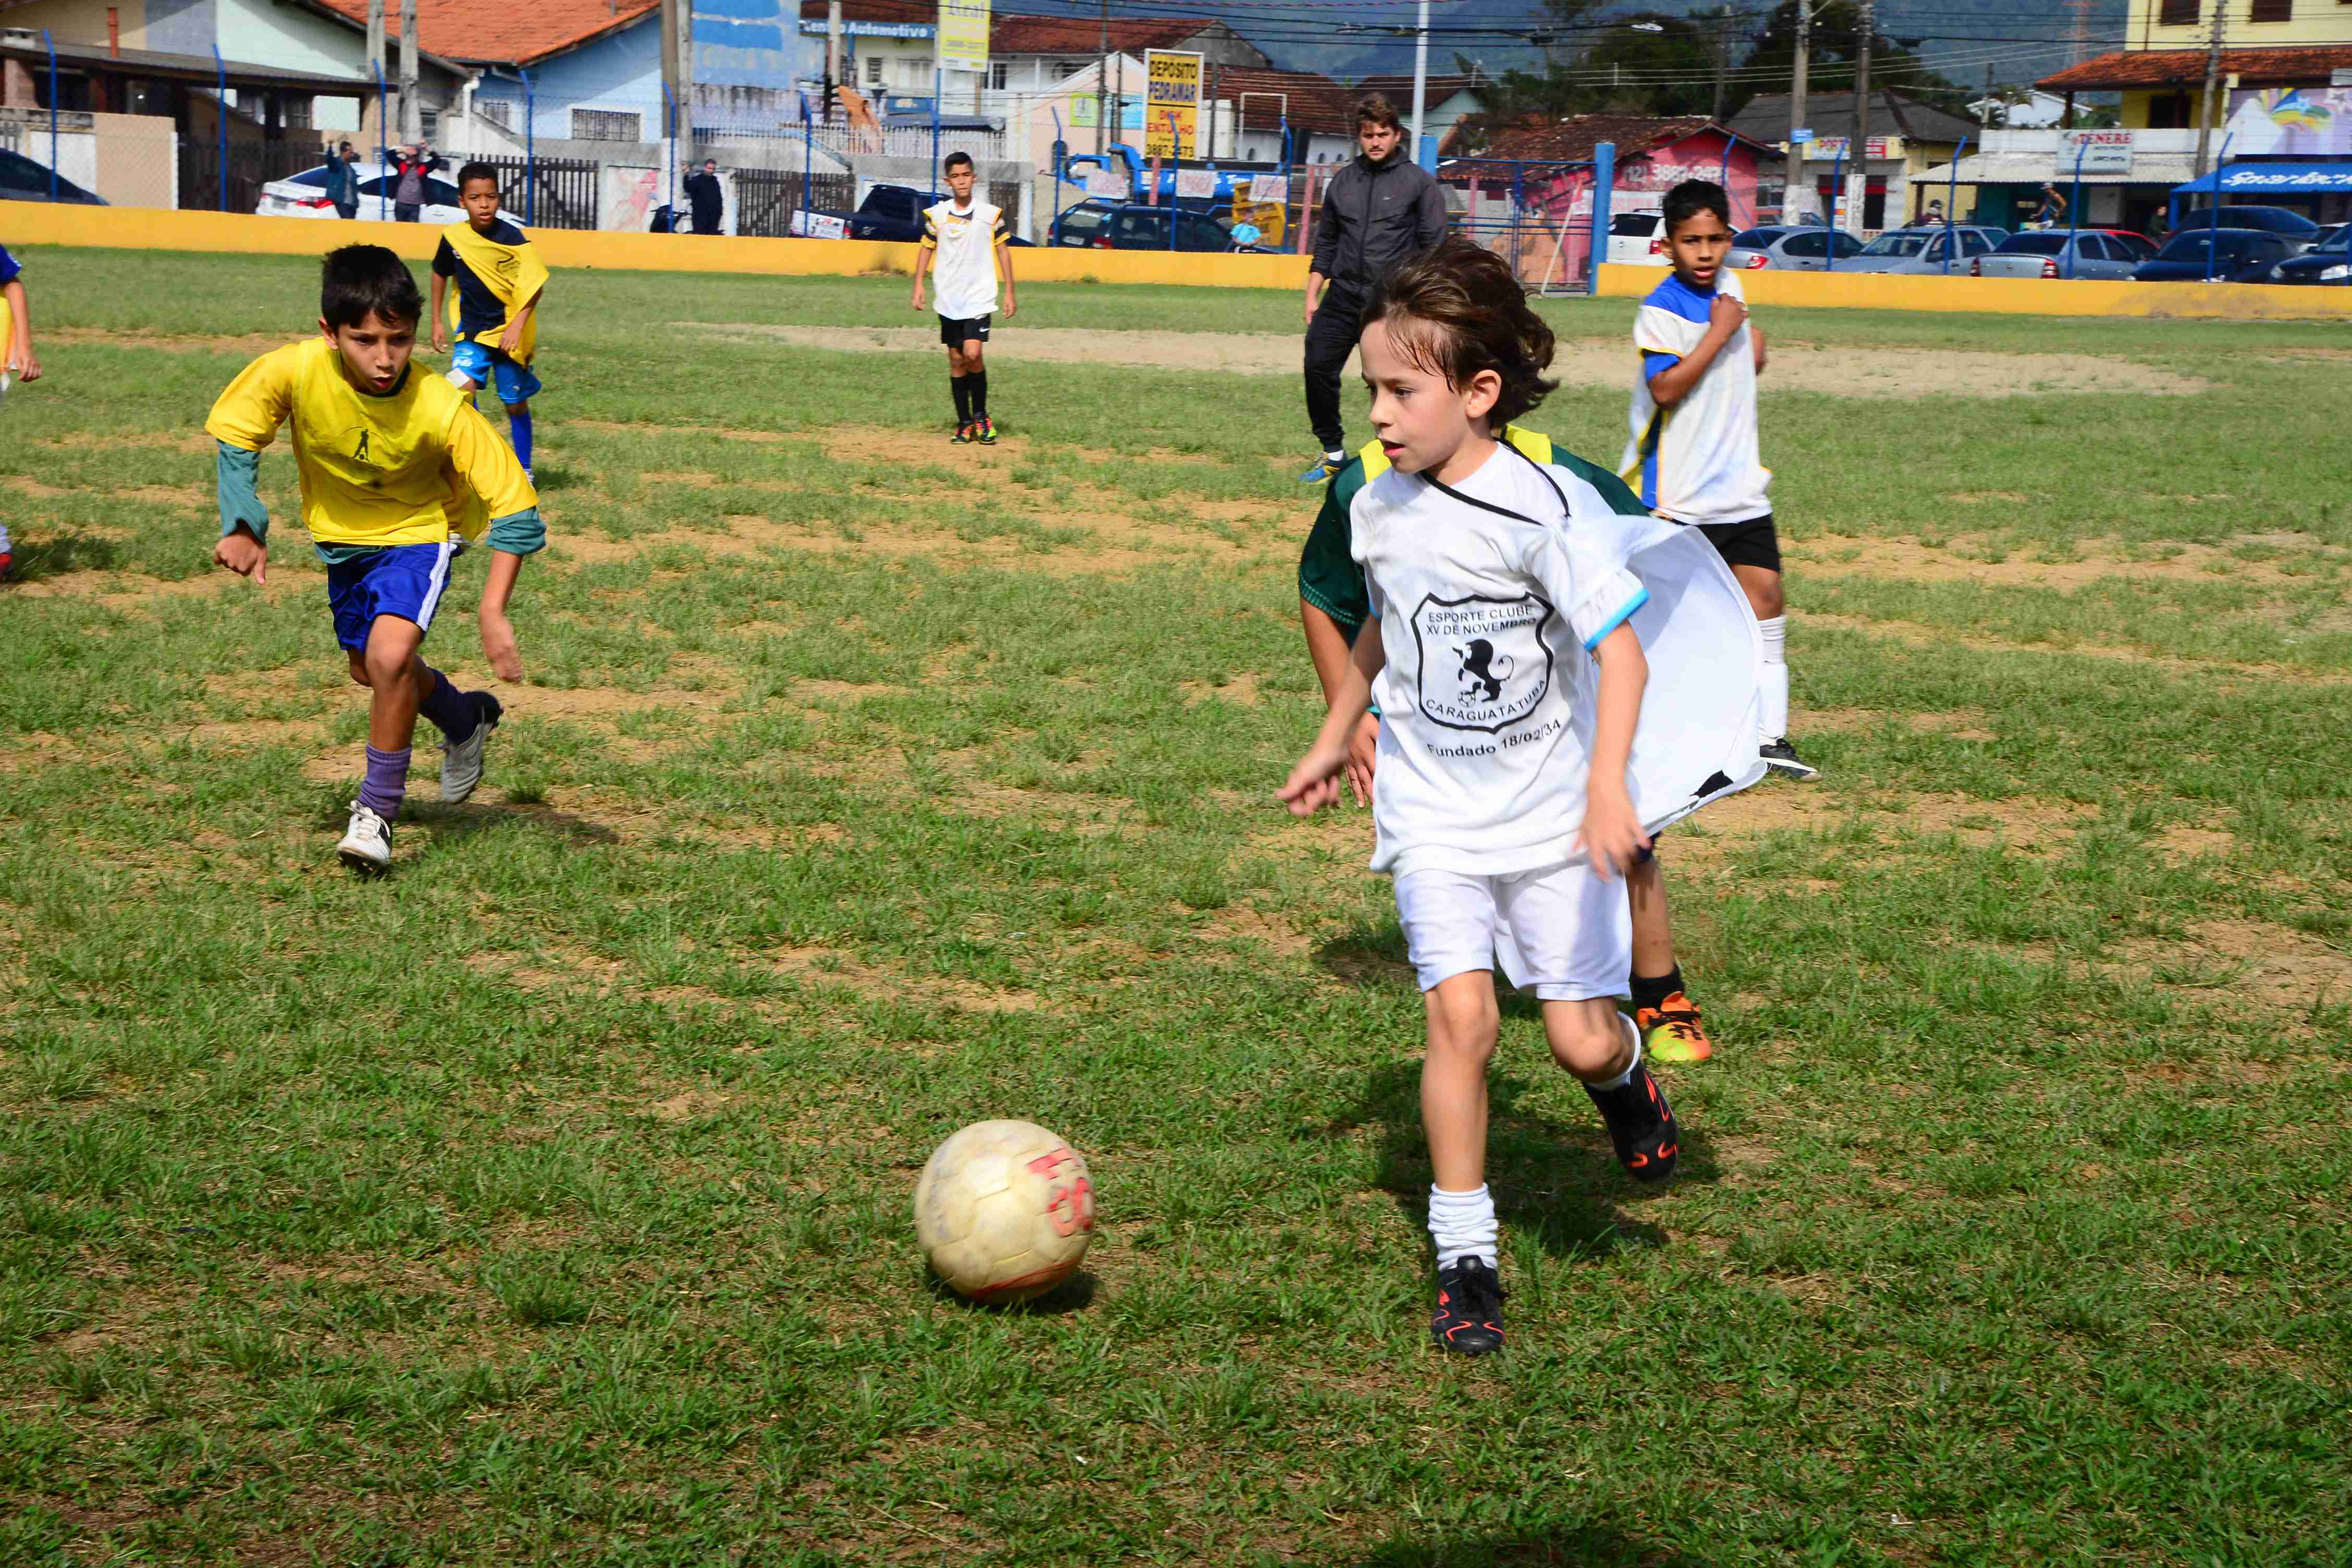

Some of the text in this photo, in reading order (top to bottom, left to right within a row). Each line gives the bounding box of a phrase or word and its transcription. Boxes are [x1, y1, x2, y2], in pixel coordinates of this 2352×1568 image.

[799, 19, 846, 34] Ceno
[1149, 80, 1195, 102] PEDRAMAR
[1147, 123, 1194, 135] ENTUHO
[1428, 605, 1534, 622] ESPORTE CLUBE
[1426, 617, 1537, 635] XV DE NOVEMBRO
[1426, 679, 1545, 722] CARAGUATATUBA
[1426, 718, 1561, 757] Fundado 18/02/34
